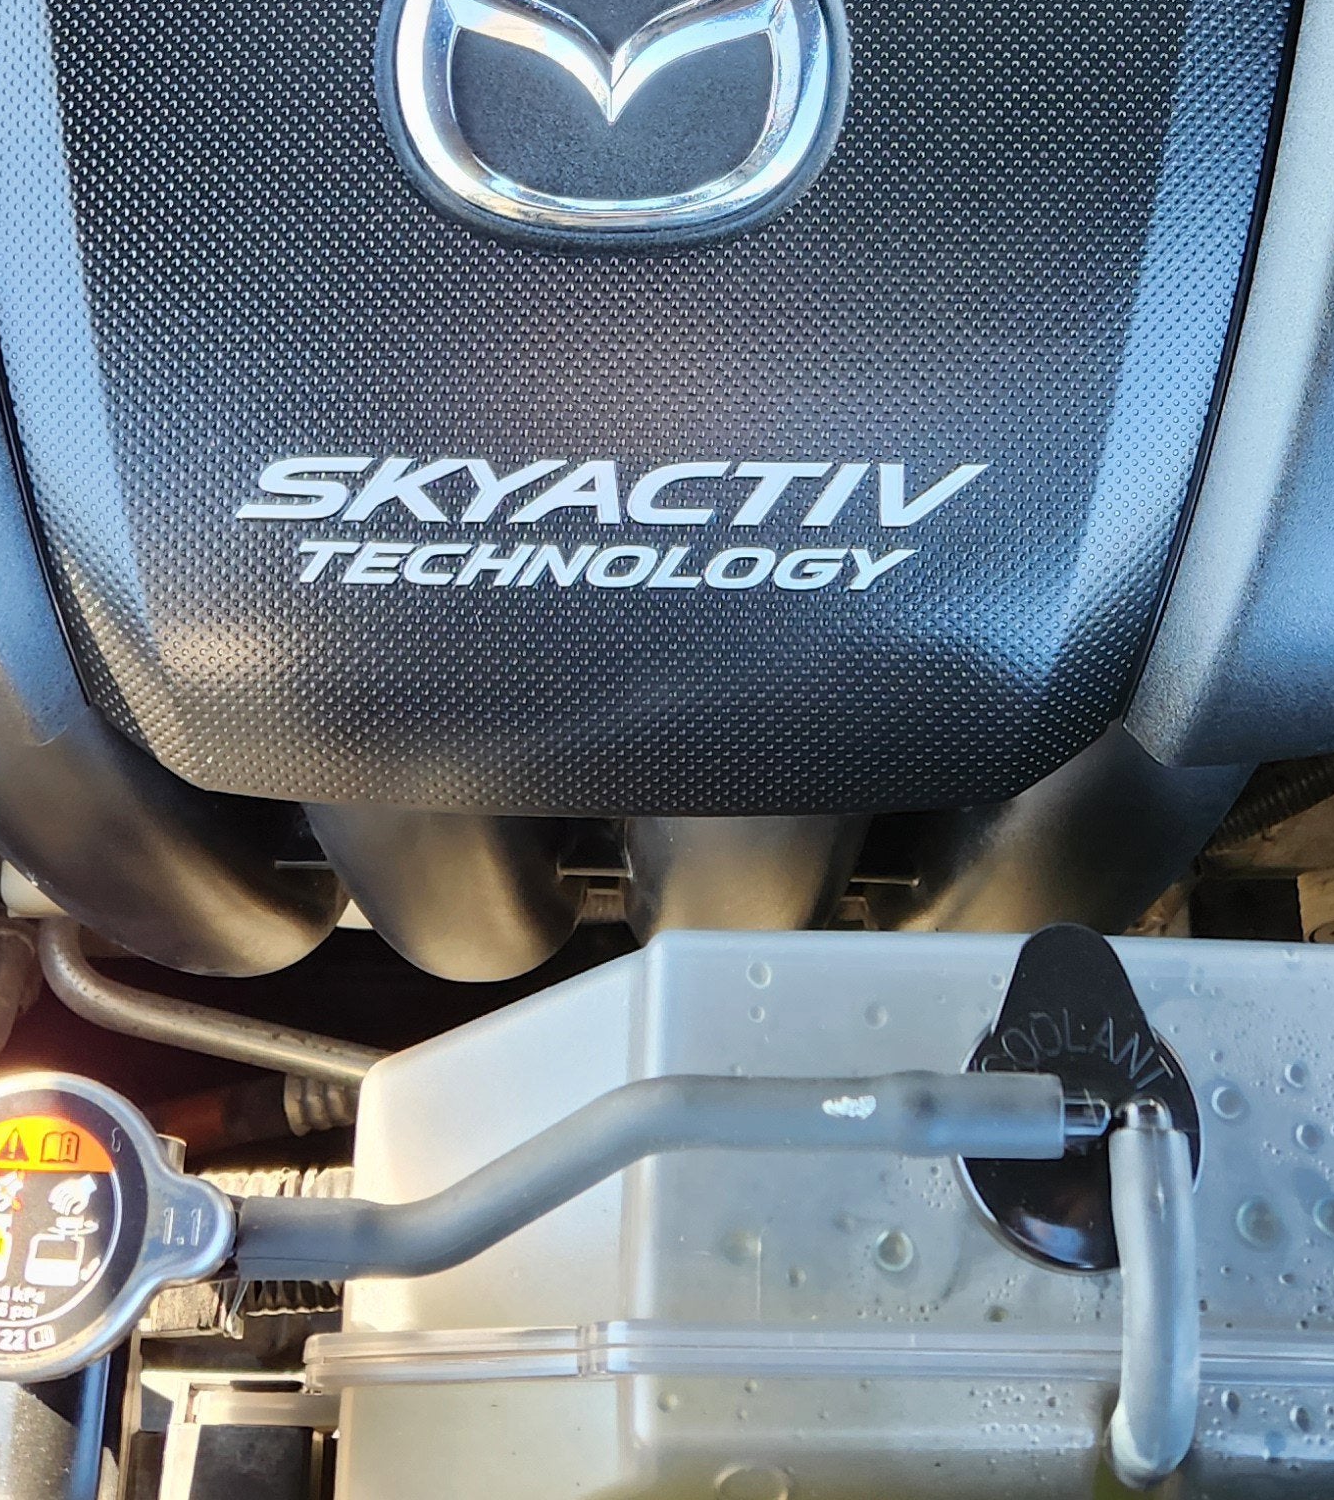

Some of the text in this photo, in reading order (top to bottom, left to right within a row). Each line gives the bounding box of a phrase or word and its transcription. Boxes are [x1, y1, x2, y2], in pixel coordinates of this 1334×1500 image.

[235, 456, 990, 529] SKYACTIV
[294, 540, 922, 592] TECHNOLOGY
[162, 1206, 202, 1247] 1.1
